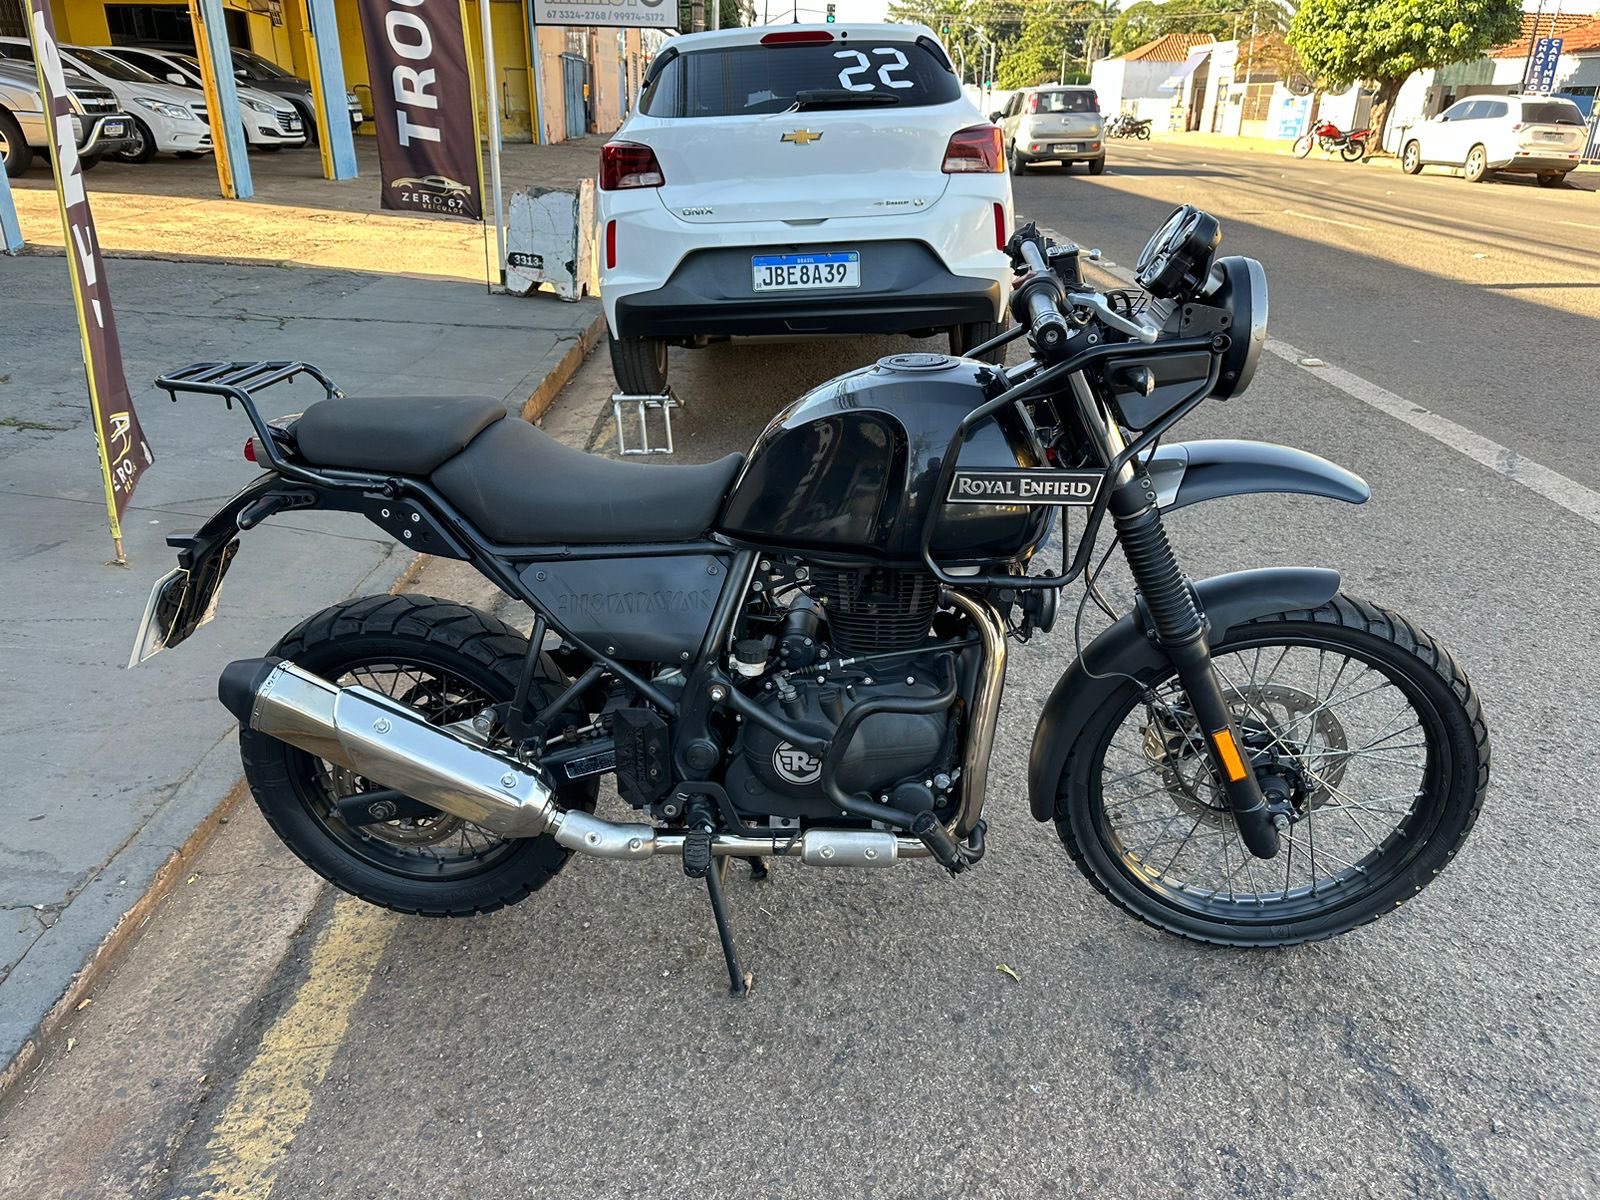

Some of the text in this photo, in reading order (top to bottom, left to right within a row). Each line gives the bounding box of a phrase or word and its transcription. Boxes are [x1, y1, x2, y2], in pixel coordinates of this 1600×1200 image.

[547, 10, 557, 19] 67
[559, 10, 607, 20] 3324-2768
[385, 0, 441, 147] TRO
[833, 47, 914, 92] 22
[1528, 39, 1548, 91] CHAVEIRO
[1540, 39, 1560, 92] CARIMBO
[401, 192, 464, 208] ZERO 67
[682, 207, 713, 216] ONIX
[762, 263, 847, 287] JBE8A39
[958, 477, 1092, 497] ROYAL ENFIELD
